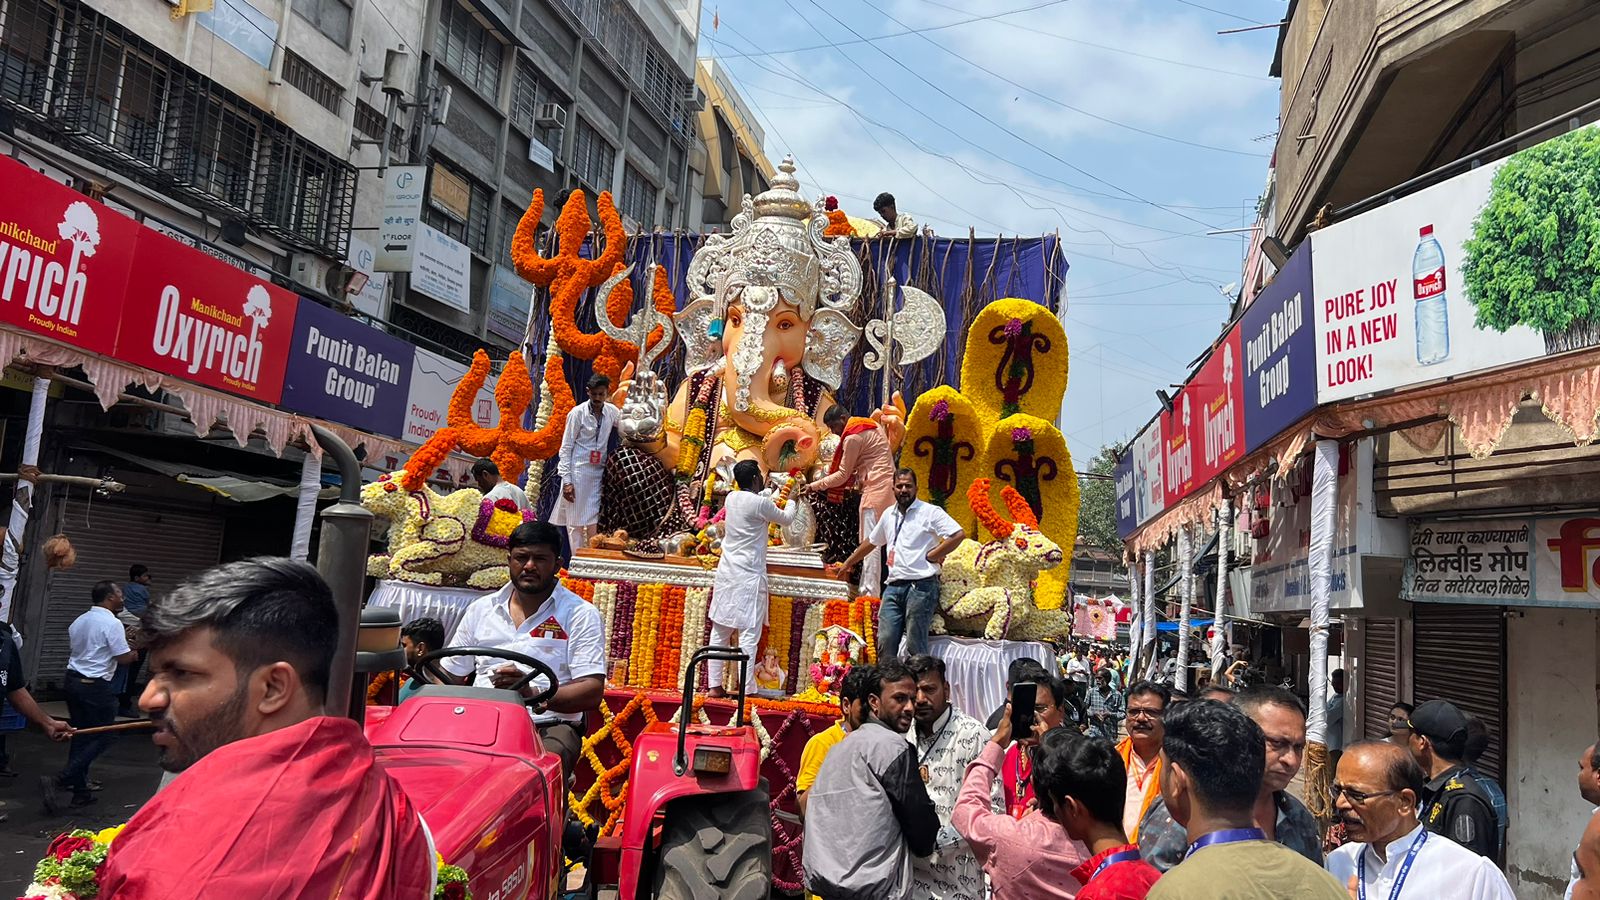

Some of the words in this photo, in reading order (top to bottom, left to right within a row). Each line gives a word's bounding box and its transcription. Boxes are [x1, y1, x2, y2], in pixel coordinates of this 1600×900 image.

[191, 297, 243, 327] Manikchand
[1325, 289, 1365, 323] PURE
[1369, 278, 1398, 311] JOY
[28, 313, 56, 332] Proudly
[56, 324, 78, 337] Indian
[153, 284, 263, 384] Oxyrich
[1246, 322, 1271, 377] Punit
[1271, 291, 1302, 353] Balan
[1326, 328, 1342, 355] IN
[1346, 325, 1357, 350] A
[1361, 313, 1398, 346] NEW
[306, 326, 353, 369] Punit
[354, 345, 401, 386] Balan
[1328, 353, 1373, 387] LOOK!
[325, 366, 376, 409] Group
[1260, 354, 1290, 409] Group
[411, 403, 441, 426] Proudly
[1412, 545, 1483, 573] लिक्वीड
[1488, 545, 1529, 572] सोप
